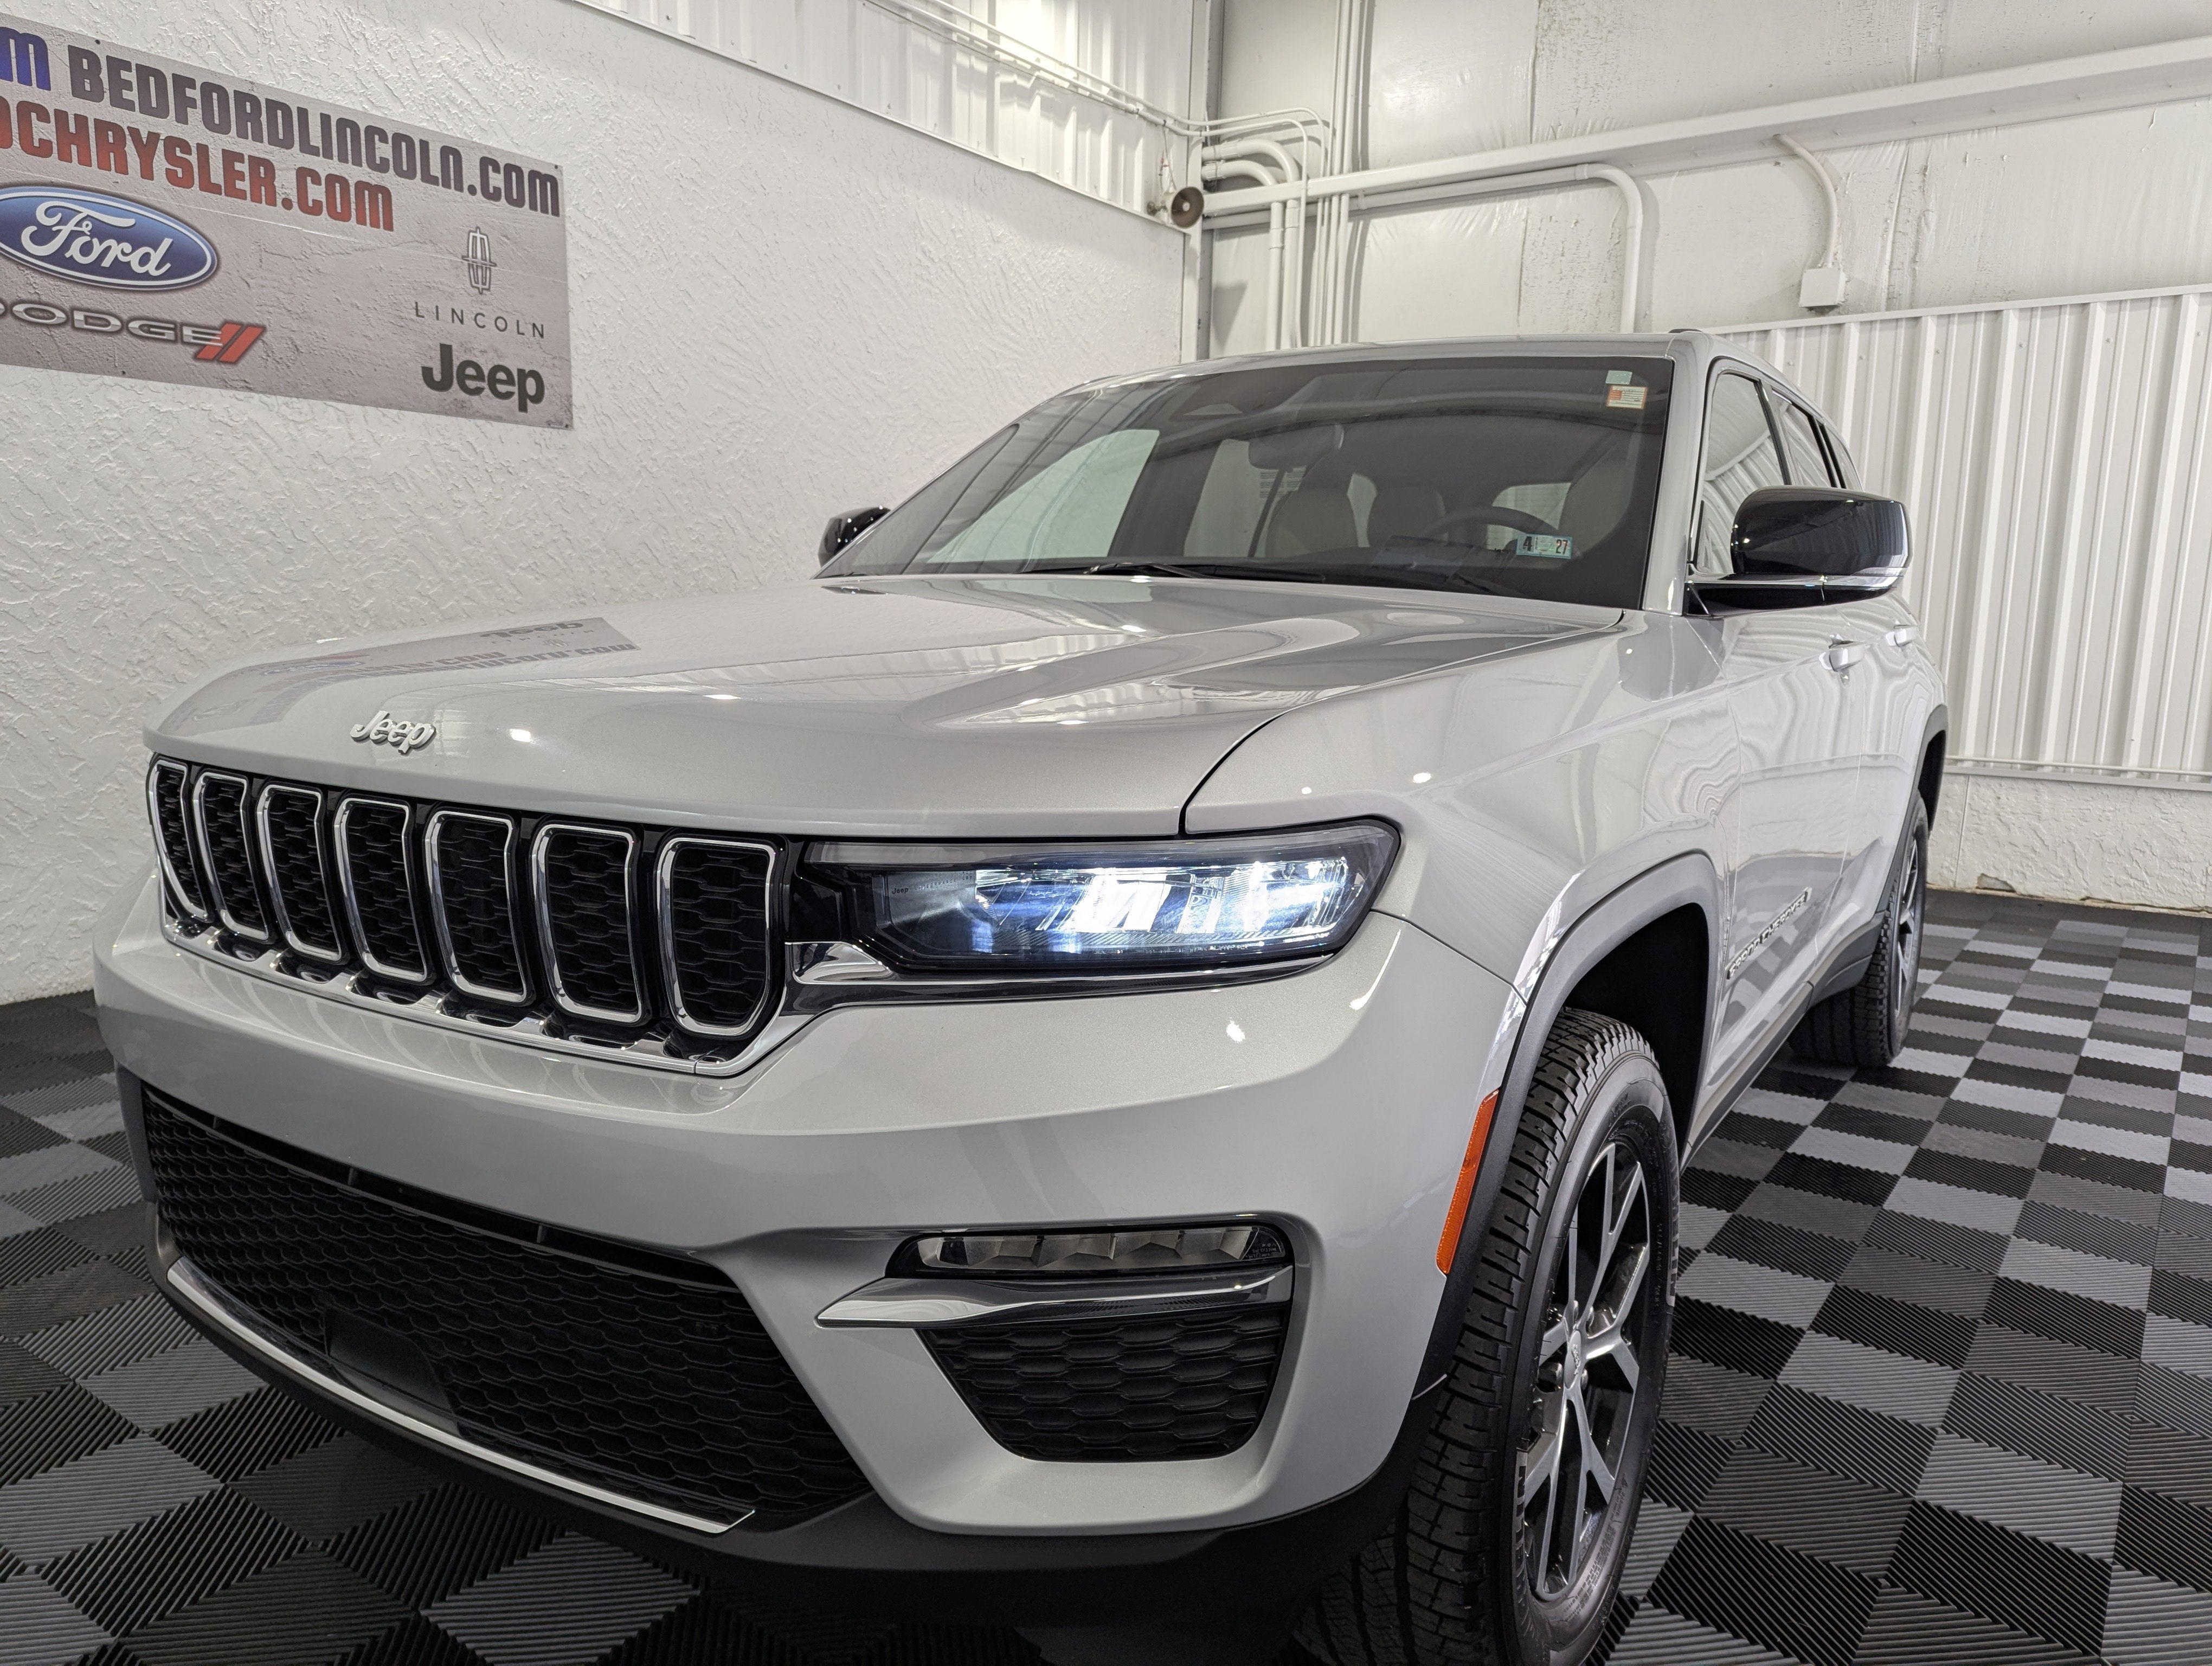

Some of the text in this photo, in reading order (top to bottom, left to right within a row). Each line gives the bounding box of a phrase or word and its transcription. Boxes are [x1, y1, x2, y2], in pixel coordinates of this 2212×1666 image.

[68, 44, 560, 217] BEDFORDLINCOLN.COM
[21, 201, 173, 277] Ford
[0, 302, 223, 347] ODGE
[415, 302, 544, 339] LINCOLN
[421, 343, 545, 414] Jeep
[1522, 536, 1533, 552] 4
[1555, 539, 1568, 555] 27
[350, 710, 436, 754] Jeep
